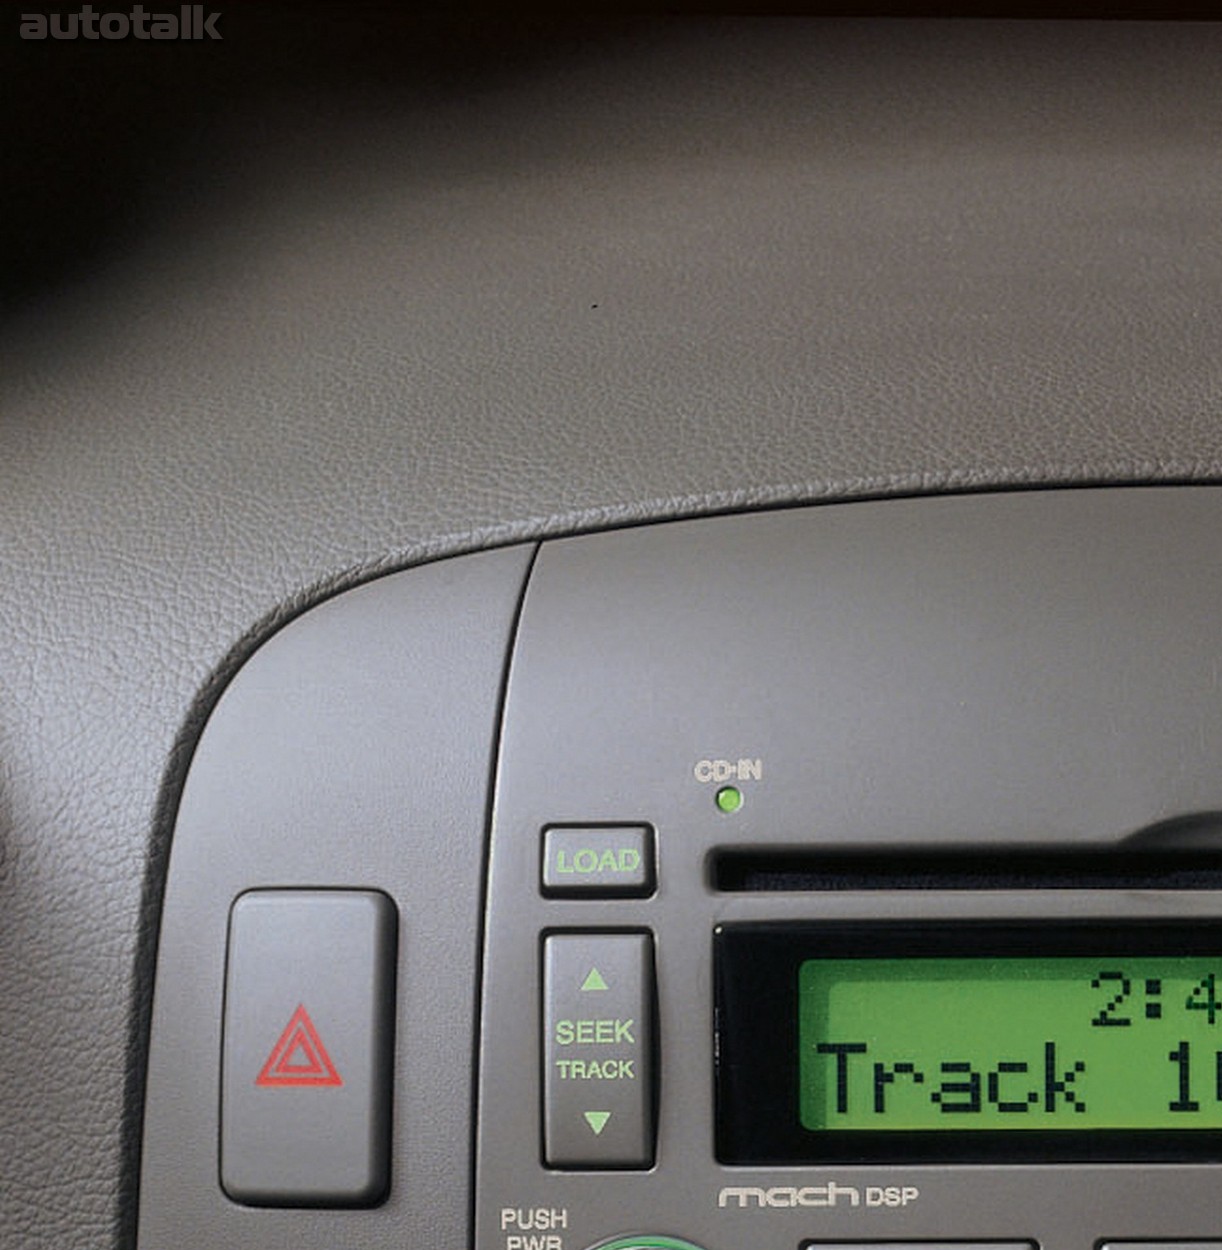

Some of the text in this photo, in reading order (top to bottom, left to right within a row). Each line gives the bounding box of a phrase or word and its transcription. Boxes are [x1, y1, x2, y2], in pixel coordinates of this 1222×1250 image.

[556, 849, 640, 874] LOAD
[556, 1020, 634, 1044] SEEK
[556, 1060, 634, 1079] TRACK
[817, 1042, 1086, 1113] Track
[719, 1182, 918, 1208] mach DSP
[501, 1209, 567, 1229] PUSH
